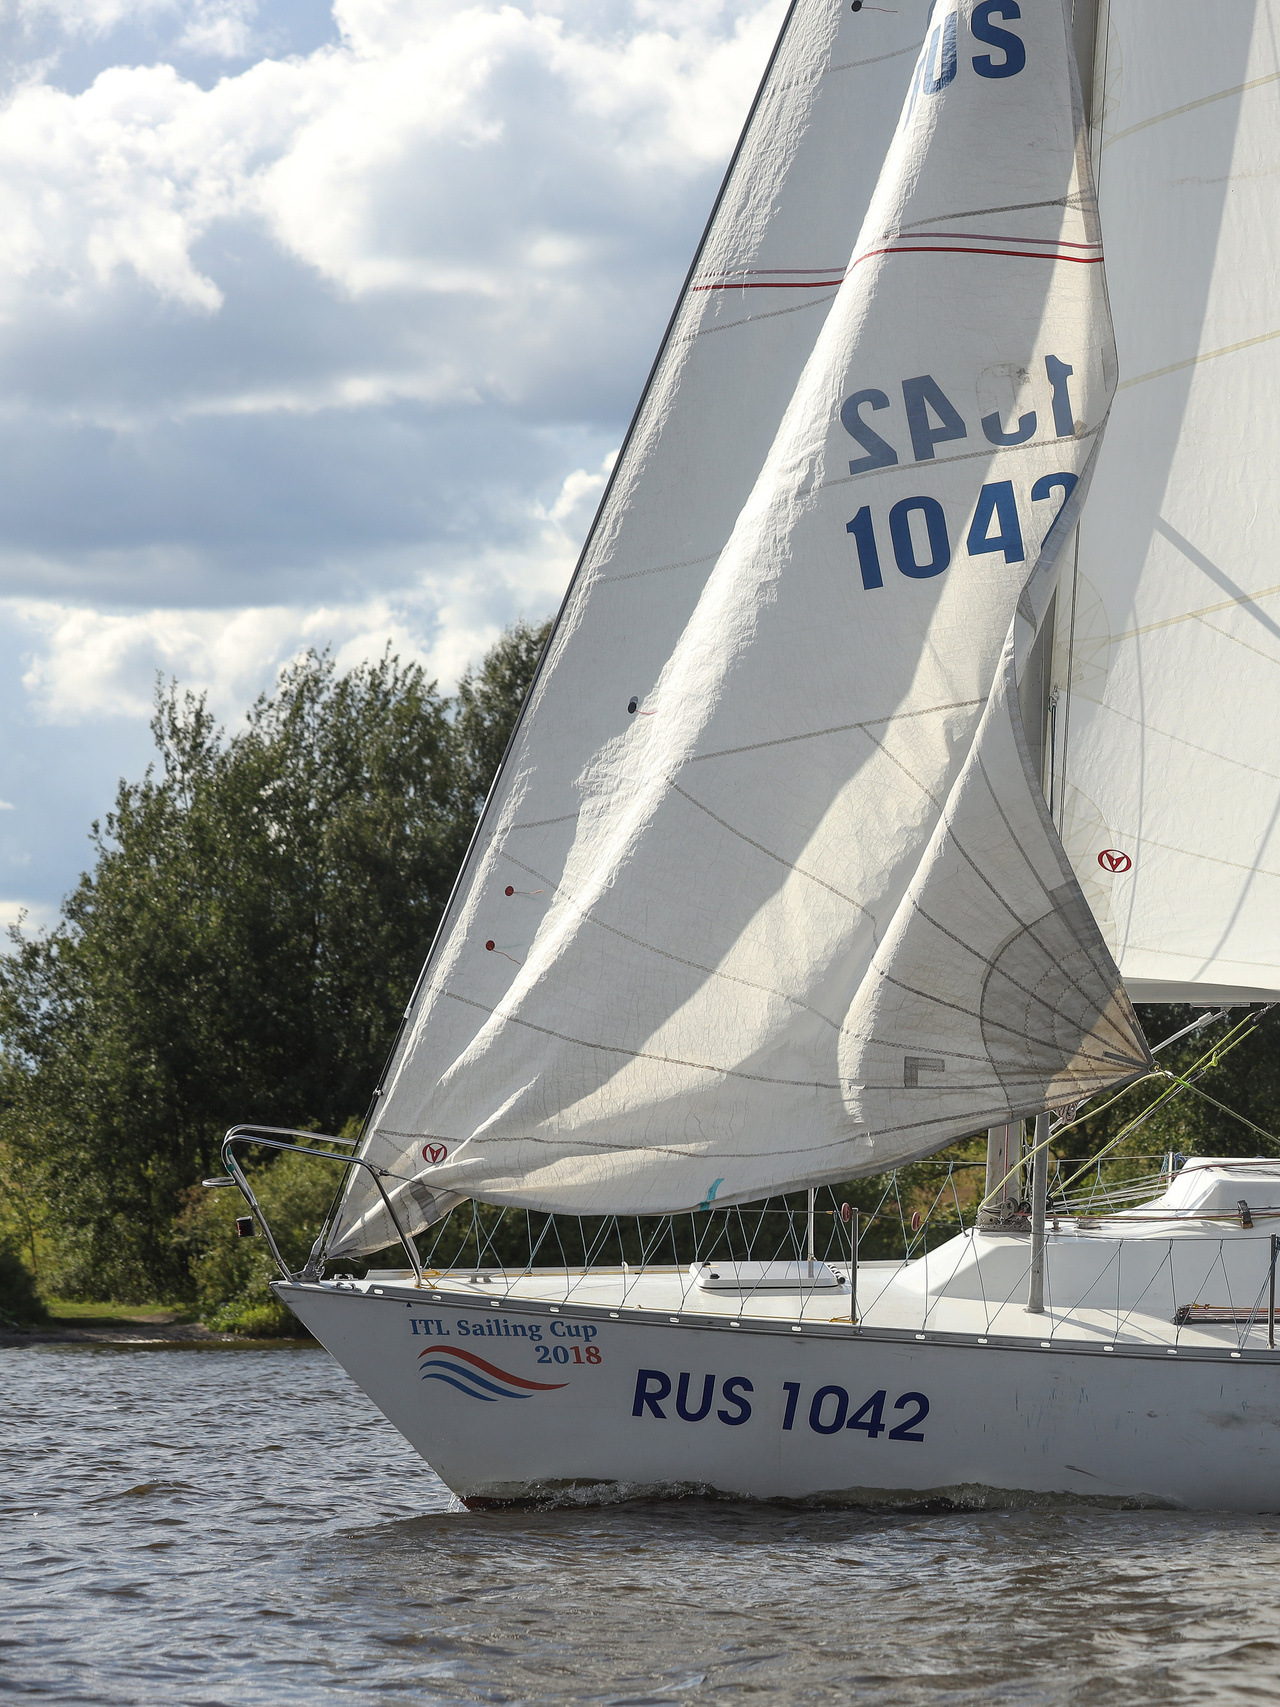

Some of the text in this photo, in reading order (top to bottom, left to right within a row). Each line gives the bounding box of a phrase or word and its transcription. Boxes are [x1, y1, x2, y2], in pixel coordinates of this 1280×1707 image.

[904, 0, 1026, 120] US
[409, 1318, 598, 1343] ITL Sailing Cup
[534, 1345, 602, 1365] 2018
[631, 1368, 930, 1442] RUS 1042
